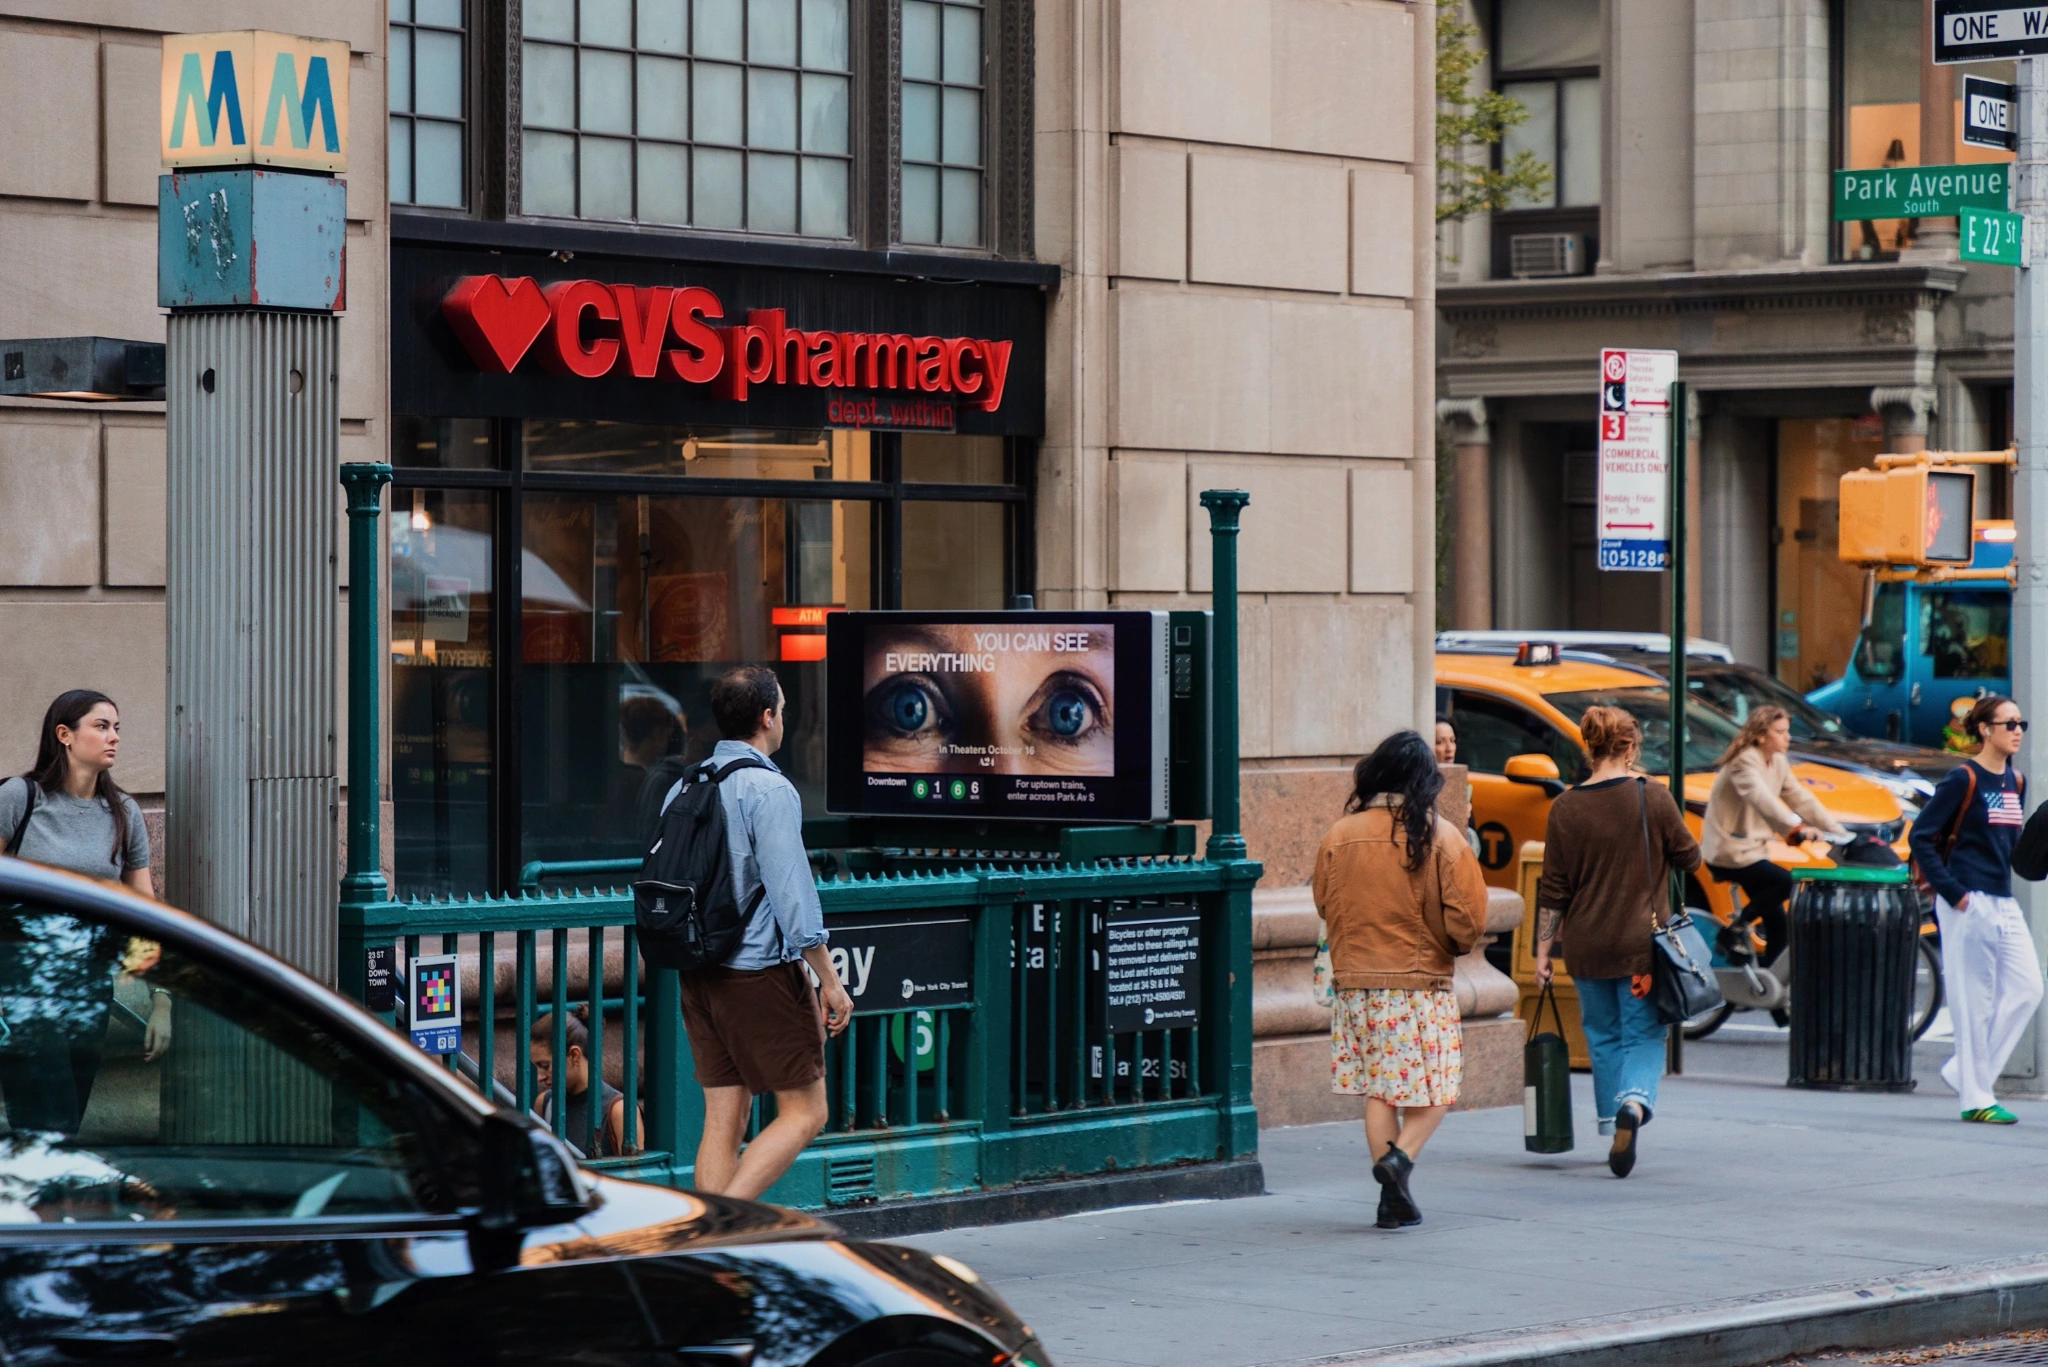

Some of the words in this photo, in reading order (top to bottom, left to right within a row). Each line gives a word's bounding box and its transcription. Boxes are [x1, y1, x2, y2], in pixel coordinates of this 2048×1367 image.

[1953, 14, 1999, 41] ONE
[2023, 10, 2048, 35] WA
[1979, 100, 2007, 128] ONE
[1844, 173, 1897, 200] Park
[1909, 172, 2001, 198] Avenue
[1904, 200, 1940, 214] South
[1969, 216, 1977, 253] E
[1983, 216, 2000, 256] 22
[2006, 221, 2016, 244] St
[550, 279, 724, 383] CVS
[716, 308, 1013, 412] pharmacy
[828, 397, 884, 430] dept.
[890, 402, 954, 428] within
[1607, 414, 1621, 440] 3
[1605, 448, 1660, 460] COMMERCIAL
[1605, 462, 1645, 473] VEHICLES
[1648, 462, 1669, 474] ONLY
[1605, 494, 1630, 504] Monday
[1636, 495, 1655, 505] Friday
[429, 598, 445, 607] self-
[428, 609, 461, 618] checkout
[798, 608, 822, 622] ATM
[974, 632, 1009, 652] YOU
[1013, 632, 1050, 652] CAN
[1053, 632, 1089, 652] SEE
[886, 652, 995, 673] EVERYTHING
[938, 744, 948, 754] In
[949, 744, 986, 755] Theaters
[988, 745, 1023, 755] October
[1026, 745, 1035, 755] 16
[979, 757, 995, 767] A24
[868, 777, 907, 787] Downtown
[916, 783, 925, 795] 6
[934, 780, 940, 793] 1
[954, 784, 962, 796] 6
[971, 781, 979, 794] 6
[1016, 779, 1029, 788] For
[1031, 780, 1060, 790] uptown
[1061, 780, 1086, 790] trains,
[1007, 792, 1027, 800] enter
[1029, 793, 1055, 801] across
[1057, 792, 1075, 802] Park
[1076, 792, 1087, 802] Av
[1088, 793, 1095, 802] S
[1481, 830, 1505, 864] T
[1109, 930, 1136, 941] Bicycles
[1144, 927, 1162, 937] other
[1162, 926, 1190, 938] property
[1109, 941, 1136, 953] attached
[1137, 942, 1144, 951] to
[1145, 940, 1163, 950] these
[1163, 938, 1187, 950] railings
[1187, 937, 1199, 947] will
[368, 951, 376, 959] 23
[376, 950, 385, 959] ST
[1109, 957, 1118, 966] be
[1118, 954, 1146, 965] removed
[1147, 953, 1159, 963] and
[1160, 951, 1189, 962] delivered
[1189, 951, 1197, 960] to
[368, 969, 390, 977] DOWN-
[1109, 969, 1120, 979] the
[1120, 968, 1135, 979] Lost
[1136, 967, 1148, 977] and
[1149, 965, 1170, 976] Found
[1170, 964, 1184, 975] Unit
[368, 978, 387, 987] TOWN
[914, 984, 926, 992] New
[926, 983, 939, 991] York
[939, 982, 951, 991] City
[951, 981, 968, 989] Transit
[1109, 981, 1133, 992] located
[1133, 980, 1141, 990] at
[1141, 980, 1150, 990] 34
[1150, 979, 1158, 989] St
[1158, 979, 1164, 989] &
[1170, 977, 1181, 988] Av.
[1124, 993, 1142, 1007] (212)
[1169, 1059, 1187, 1079] St
